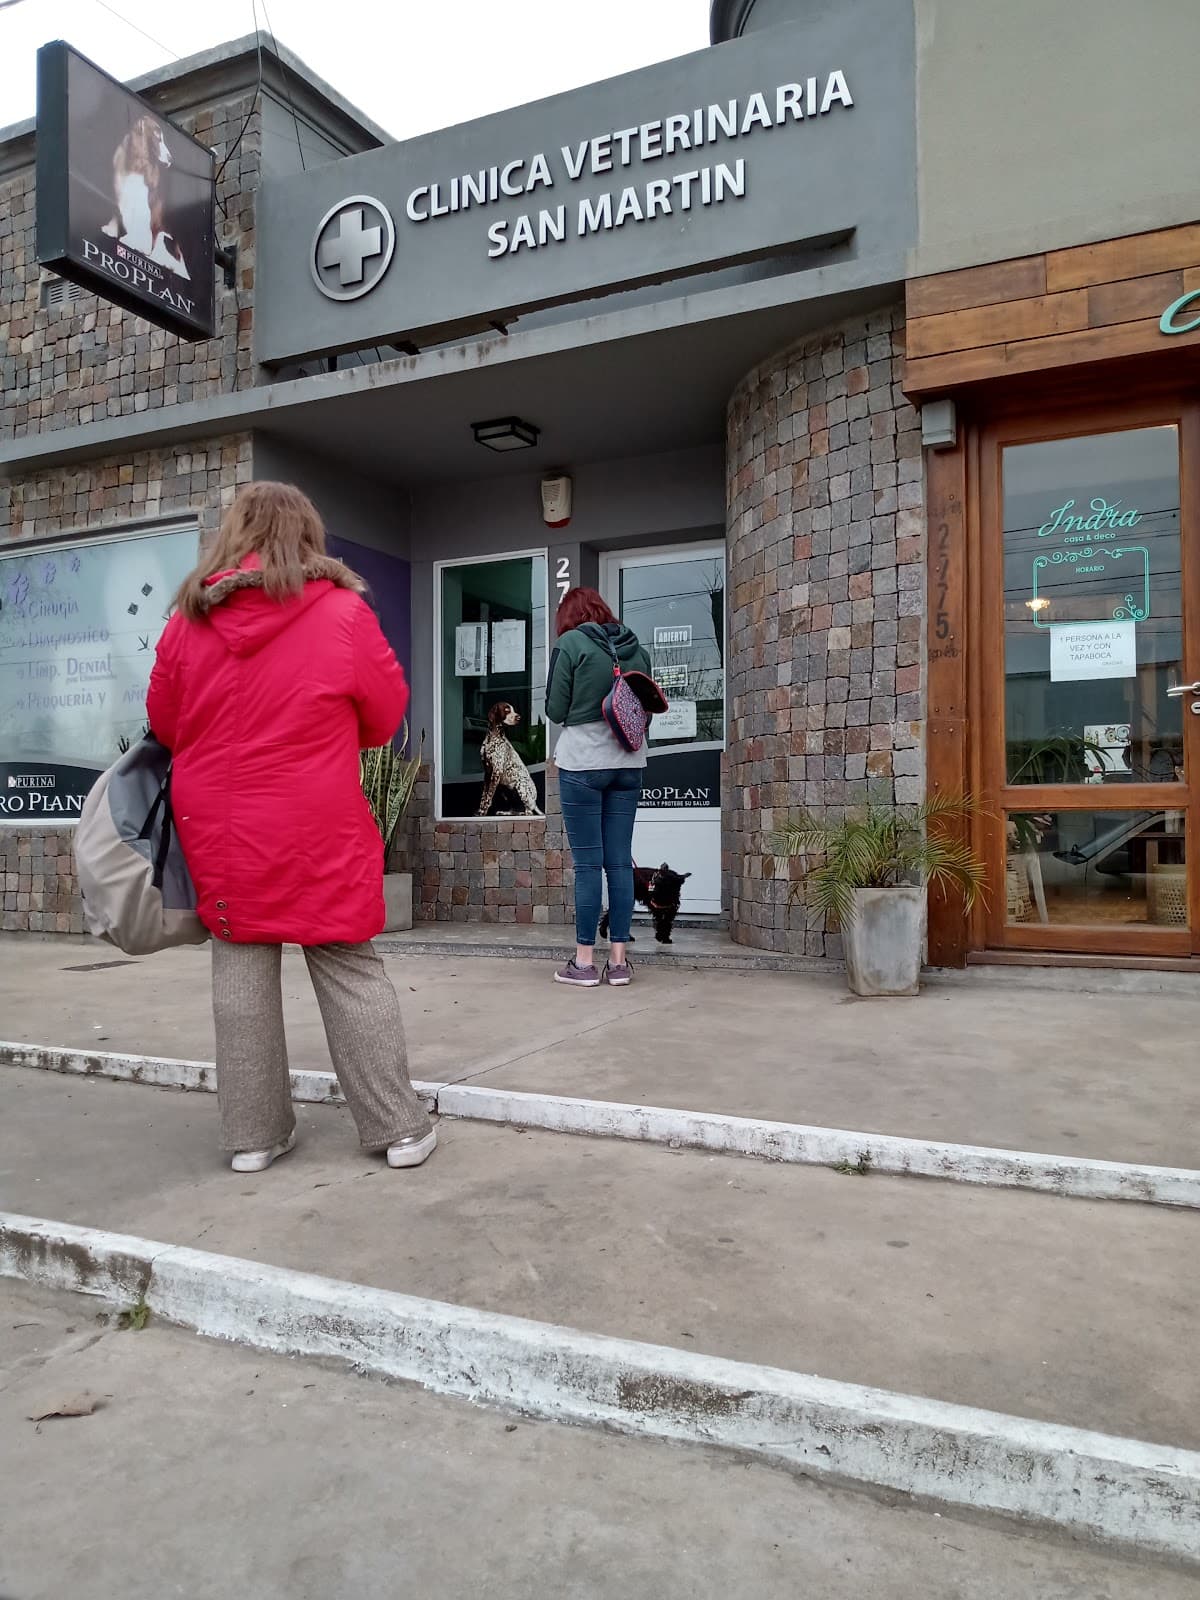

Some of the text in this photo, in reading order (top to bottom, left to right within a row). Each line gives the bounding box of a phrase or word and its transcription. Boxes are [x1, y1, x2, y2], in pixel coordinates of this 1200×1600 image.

[406, 69, 854, 222] CLINICA VETERINARIA
[487, 158, 746, 258] SAN MARTIN
[127, 253, 161, 277] PURINA
[1038, 498, 1142, 537] Indra
[1094, 532, 1116, 540] deco
[1076, 565, 1105, 573] HORARIO
[556, 557, 570, 610] 27
[1065, 633, 1103, 643] PERSONA
[1104, 632, 1110, 640] A
[1111, 632, 1122, 640] LA
[1093, 642, 1112, 650] CON
[1070, 651, 1112, 661] TAPABOCA
[17, 776, 53, 786] PURINA
